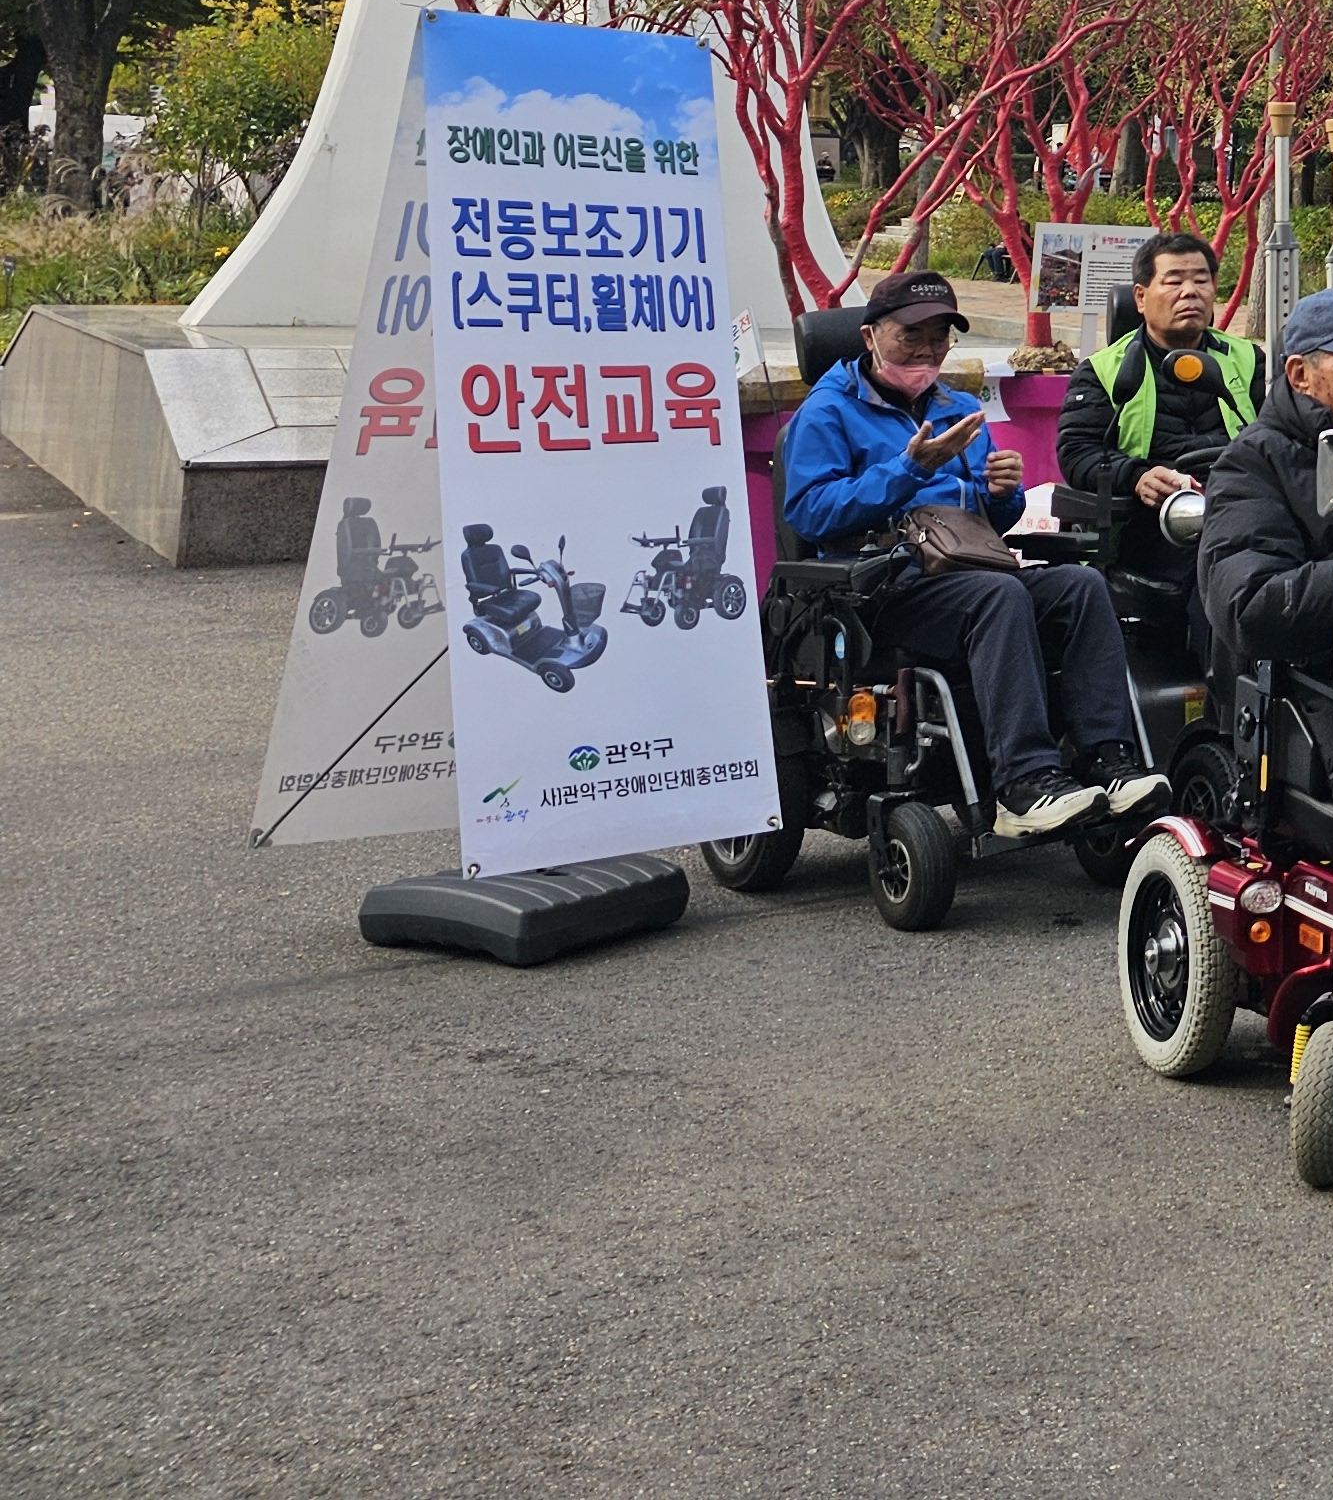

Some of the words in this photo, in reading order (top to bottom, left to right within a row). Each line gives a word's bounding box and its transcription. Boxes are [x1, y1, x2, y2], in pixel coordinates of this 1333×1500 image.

[447, 125, 545, 167] 장애인과
[553, 132, 646, 174] 어르신을
[653, 139, 699, 175] 위한
[451, 197, 706, 264] 전동보조기기
[461, 362, 721, 454] 안전교육
[605, 737, 675, 765] 관악구
